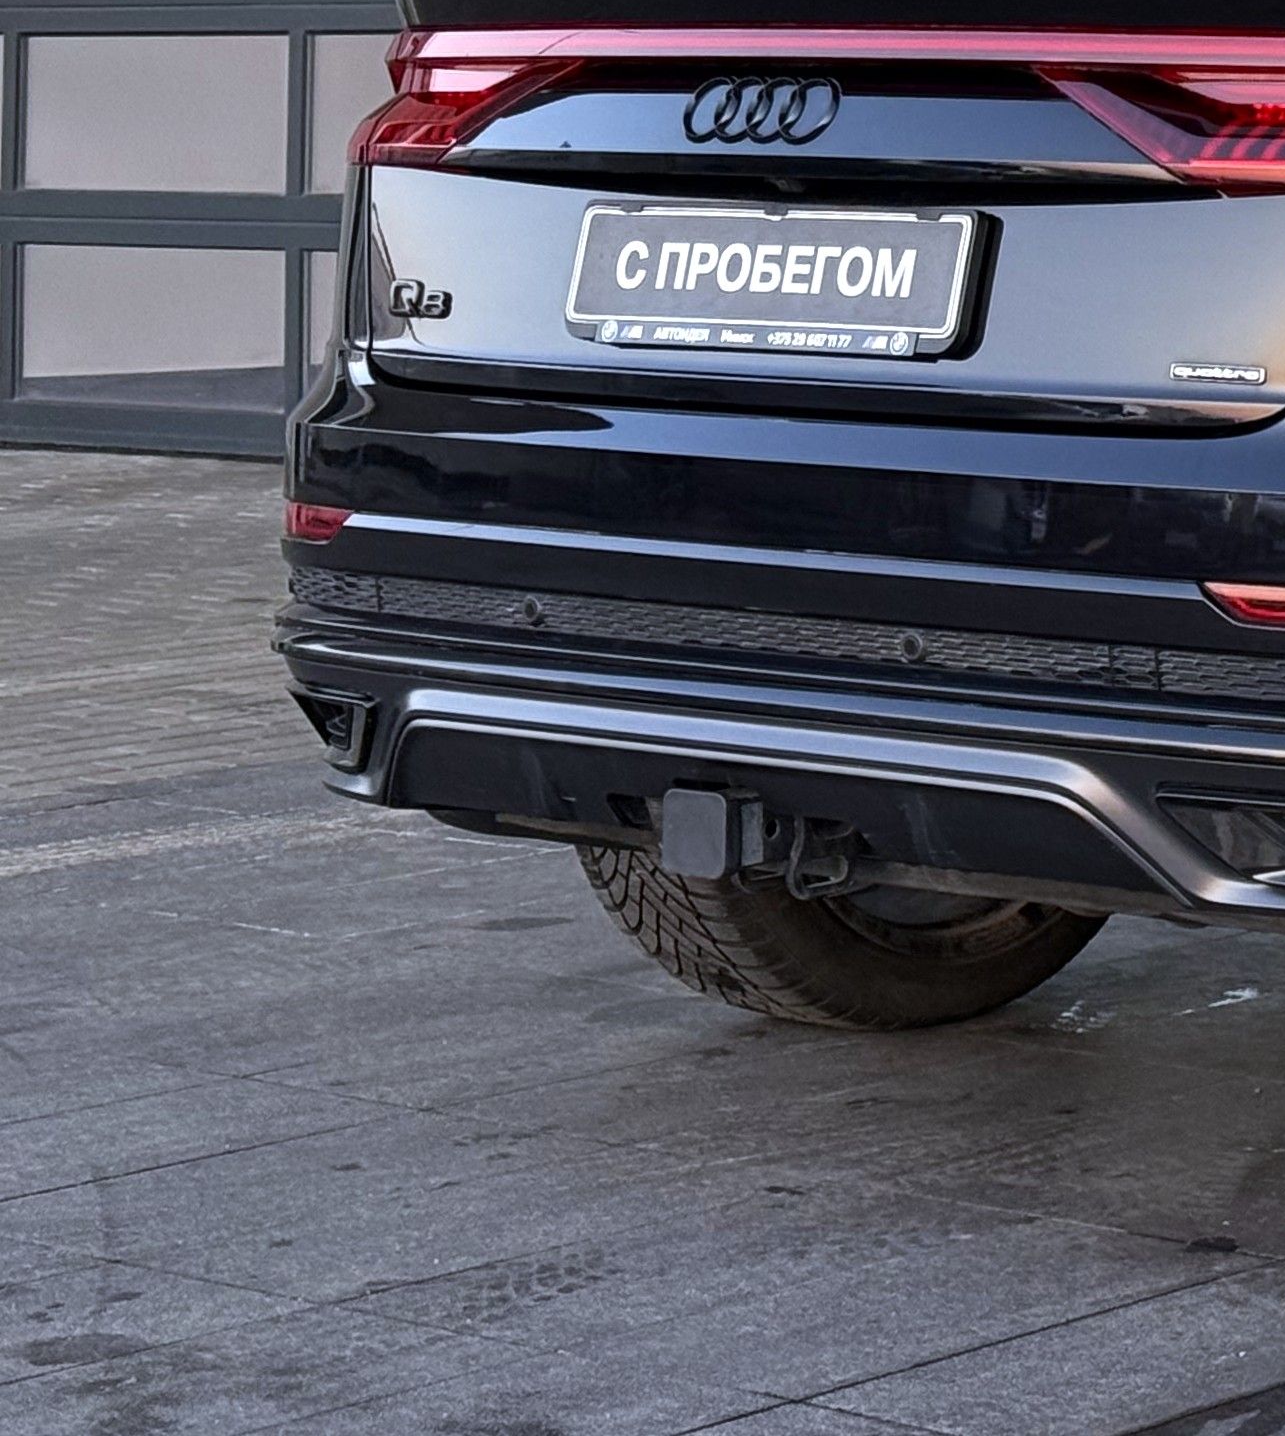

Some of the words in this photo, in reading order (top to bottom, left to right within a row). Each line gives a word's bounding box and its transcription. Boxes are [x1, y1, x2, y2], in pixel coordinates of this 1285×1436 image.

[616, 240, 650, 290] С
[655, 242, 918, 299] ПРОБЕГОМ
[389, 278, 453, 320] Q8
